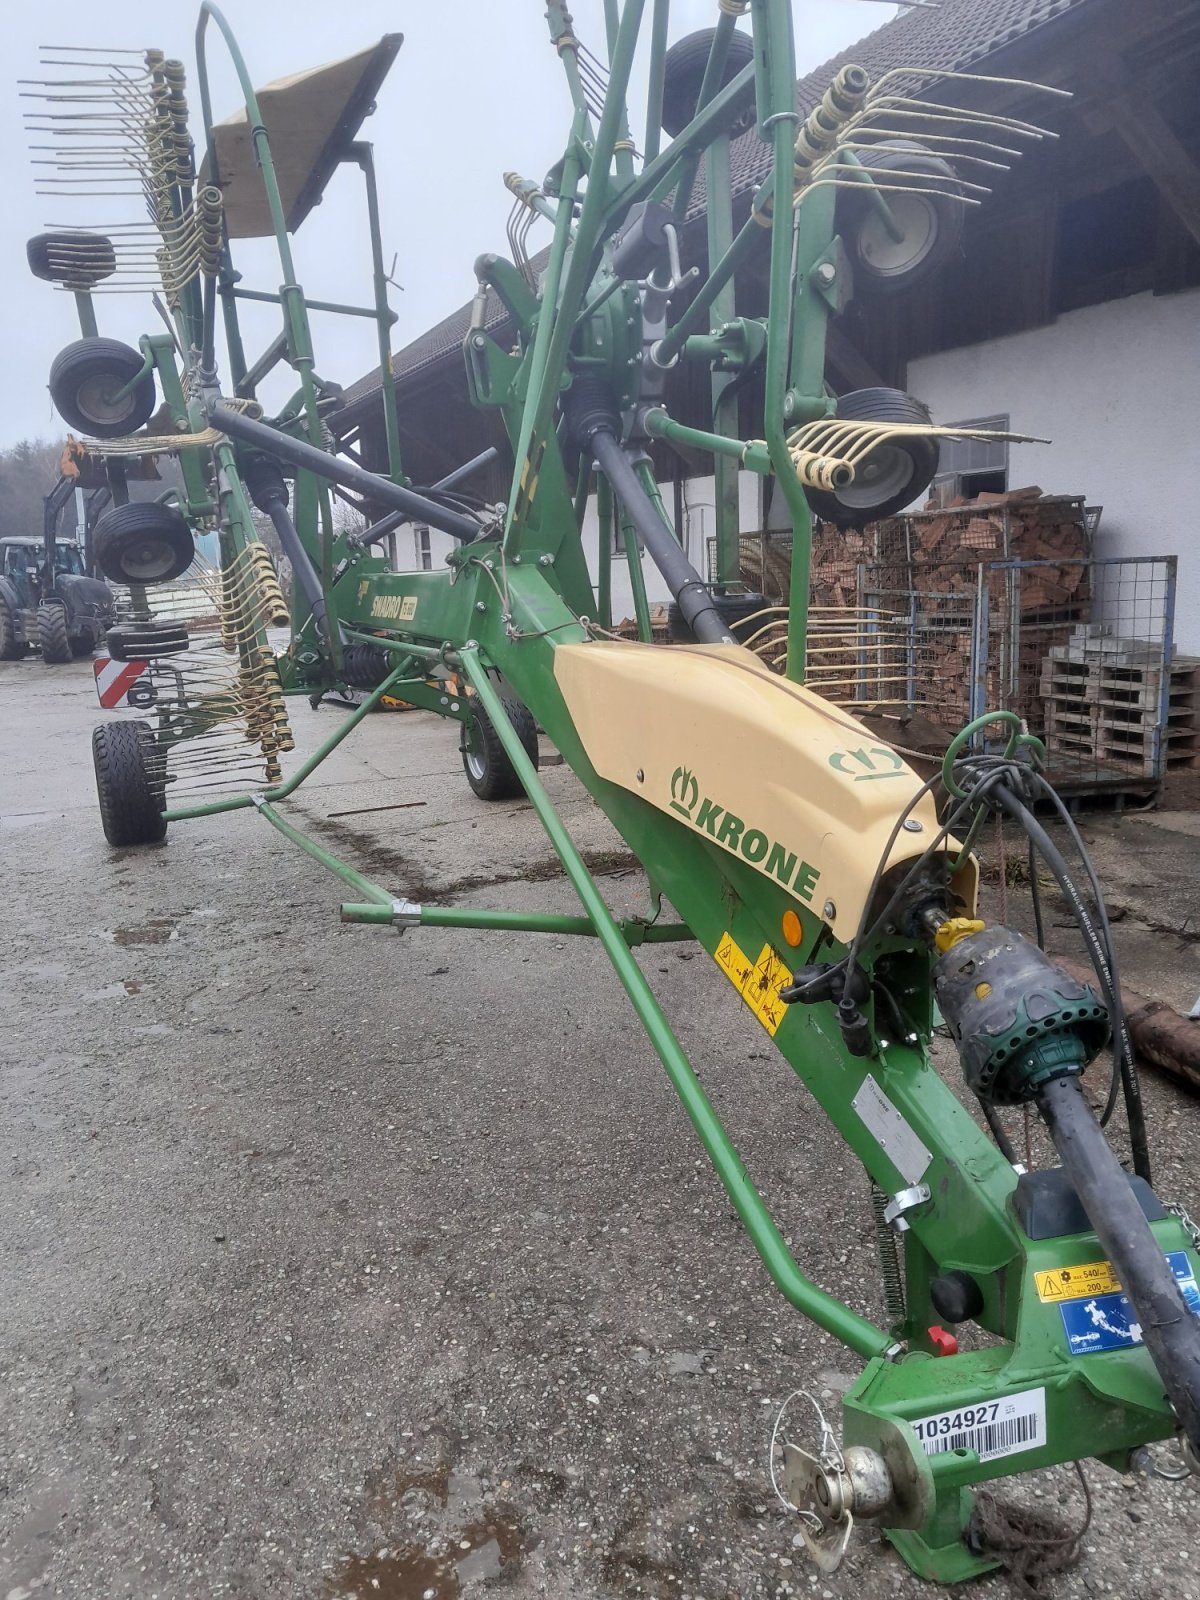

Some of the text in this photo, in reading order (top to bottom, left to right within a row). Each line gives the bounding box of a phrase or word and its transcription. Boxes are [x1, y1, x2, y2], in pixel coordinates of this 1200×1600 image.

[371, 595, 401, 619] SWADRO
[695, 798, 821, 902] KRONE
[1063, 875, 1084, 911] HYDRAULIK
[1081, 911, 1097, 941] MUELLER
[1094, 941, 1106, 965] RHEINE
[1087, 1283, 1102, 1291] 200
